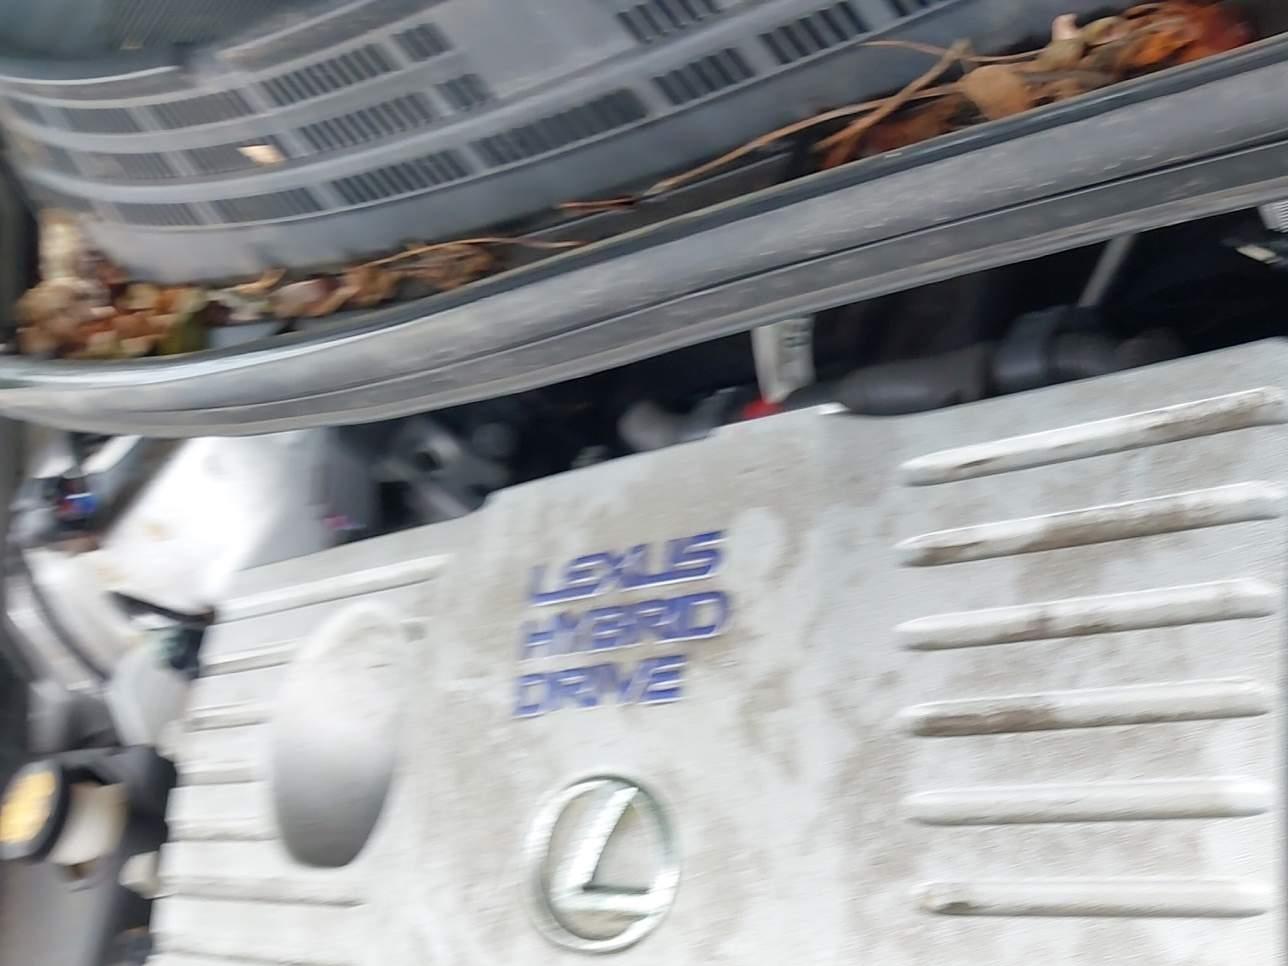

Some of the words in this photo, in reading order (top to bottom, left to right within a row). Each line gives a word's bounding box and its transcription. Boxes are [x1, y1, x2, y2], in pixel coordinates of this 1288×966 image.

[527, 529, 726, 606] LEXUS
[517, 590, 733, 661] HYBRID
[512, 655, 688, 718] DRIVE
